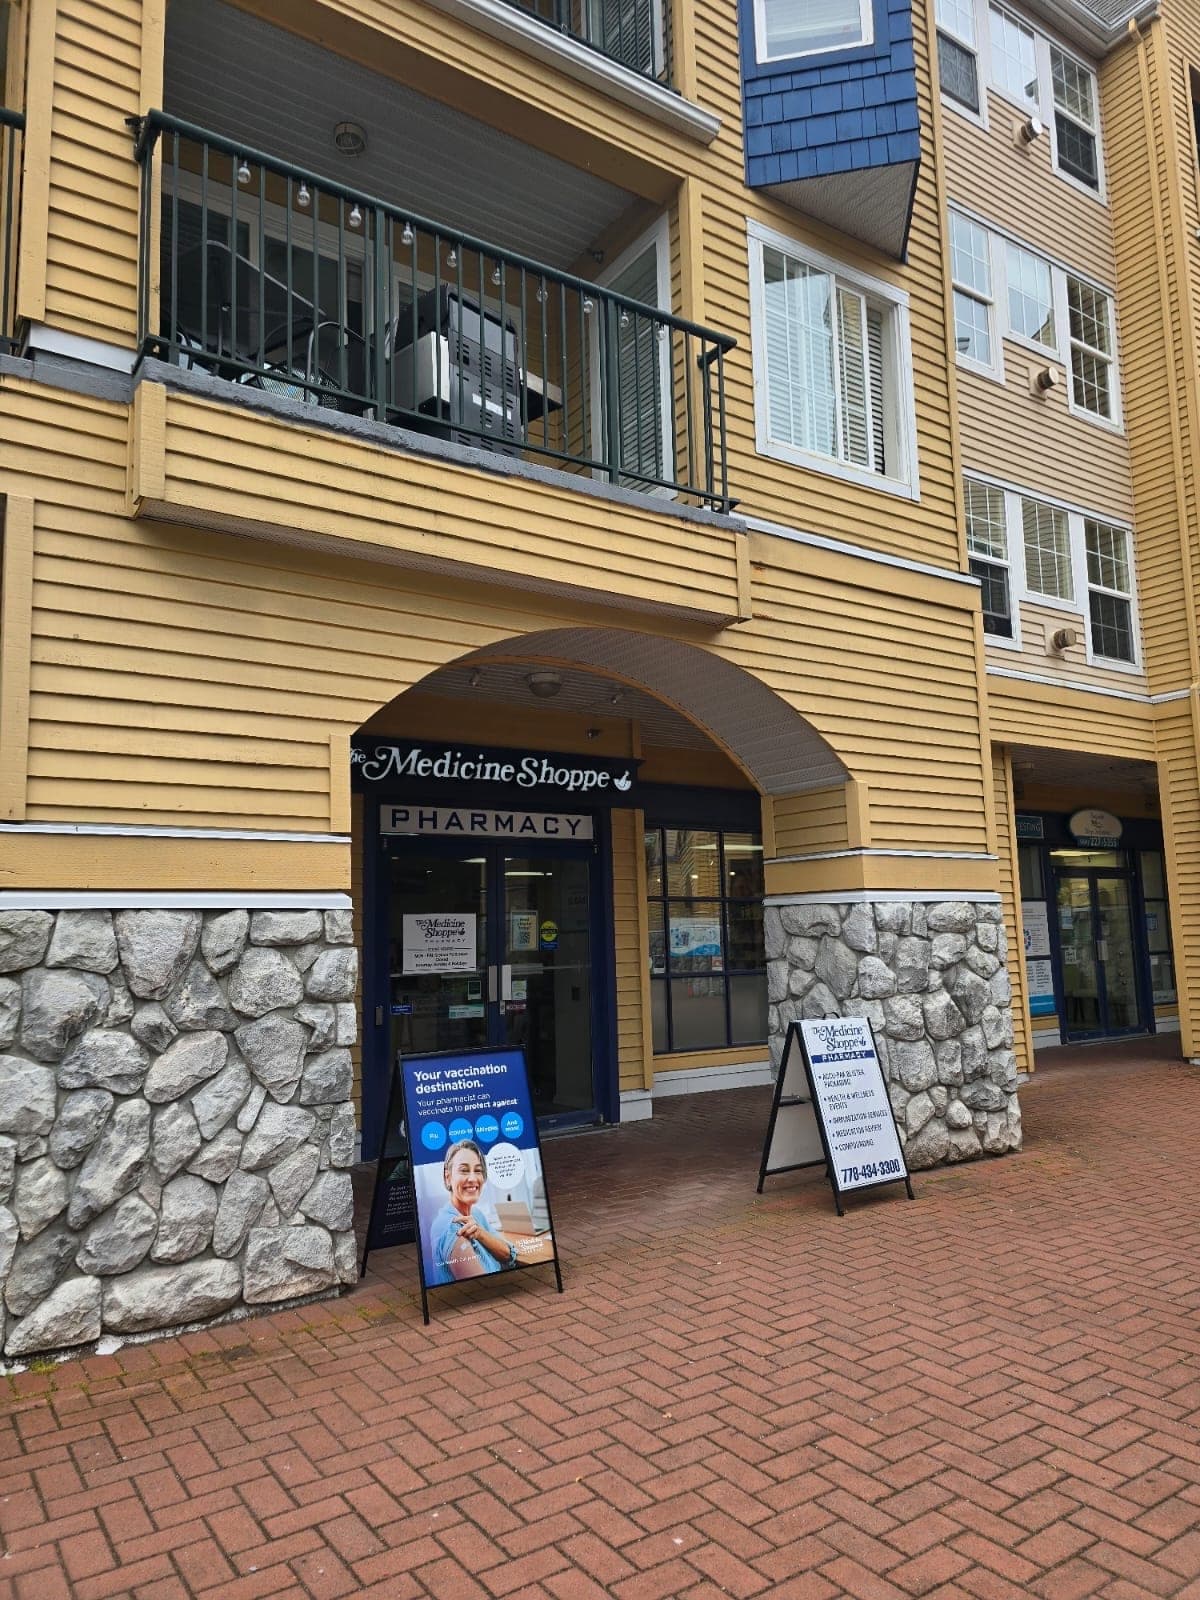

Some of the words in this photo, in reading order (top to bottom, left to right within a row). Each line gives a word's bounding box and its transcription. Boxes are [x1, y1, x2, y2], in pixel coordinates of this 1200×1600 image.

[362, 746, 515, 782] Medicine
[516, 757, 610, 792] Shoppe
[391, 808, 581, 836] PHARMACY
[421, 918, 465, 931] Medicine
[424, 928, 457, 938] Shoppe
[819, 1024, 862, 1041] Medicine
[826, 1037, 858, 1051] Shoppe
[822, 1050, 866, 1062] PHARMACY
[414, 1070, 441, 1082] Your
[445, 1063, 507, 1079] vaccination
[416, 1078, 484, 1094] destination.
[417, 1099, 434, 1107] Your
[436, 1094, 476, 1106] pharmacist
[477, 1092, 491, 1100] can
[418, 1106, 453, 1116] vaccinate
[454, 1104, 463, 1112] to
[464, 1101, 491, 1112] protect
[492, 1098, 518, 1109] against
[841, 1159, 901, 1183] 778-434-3300
